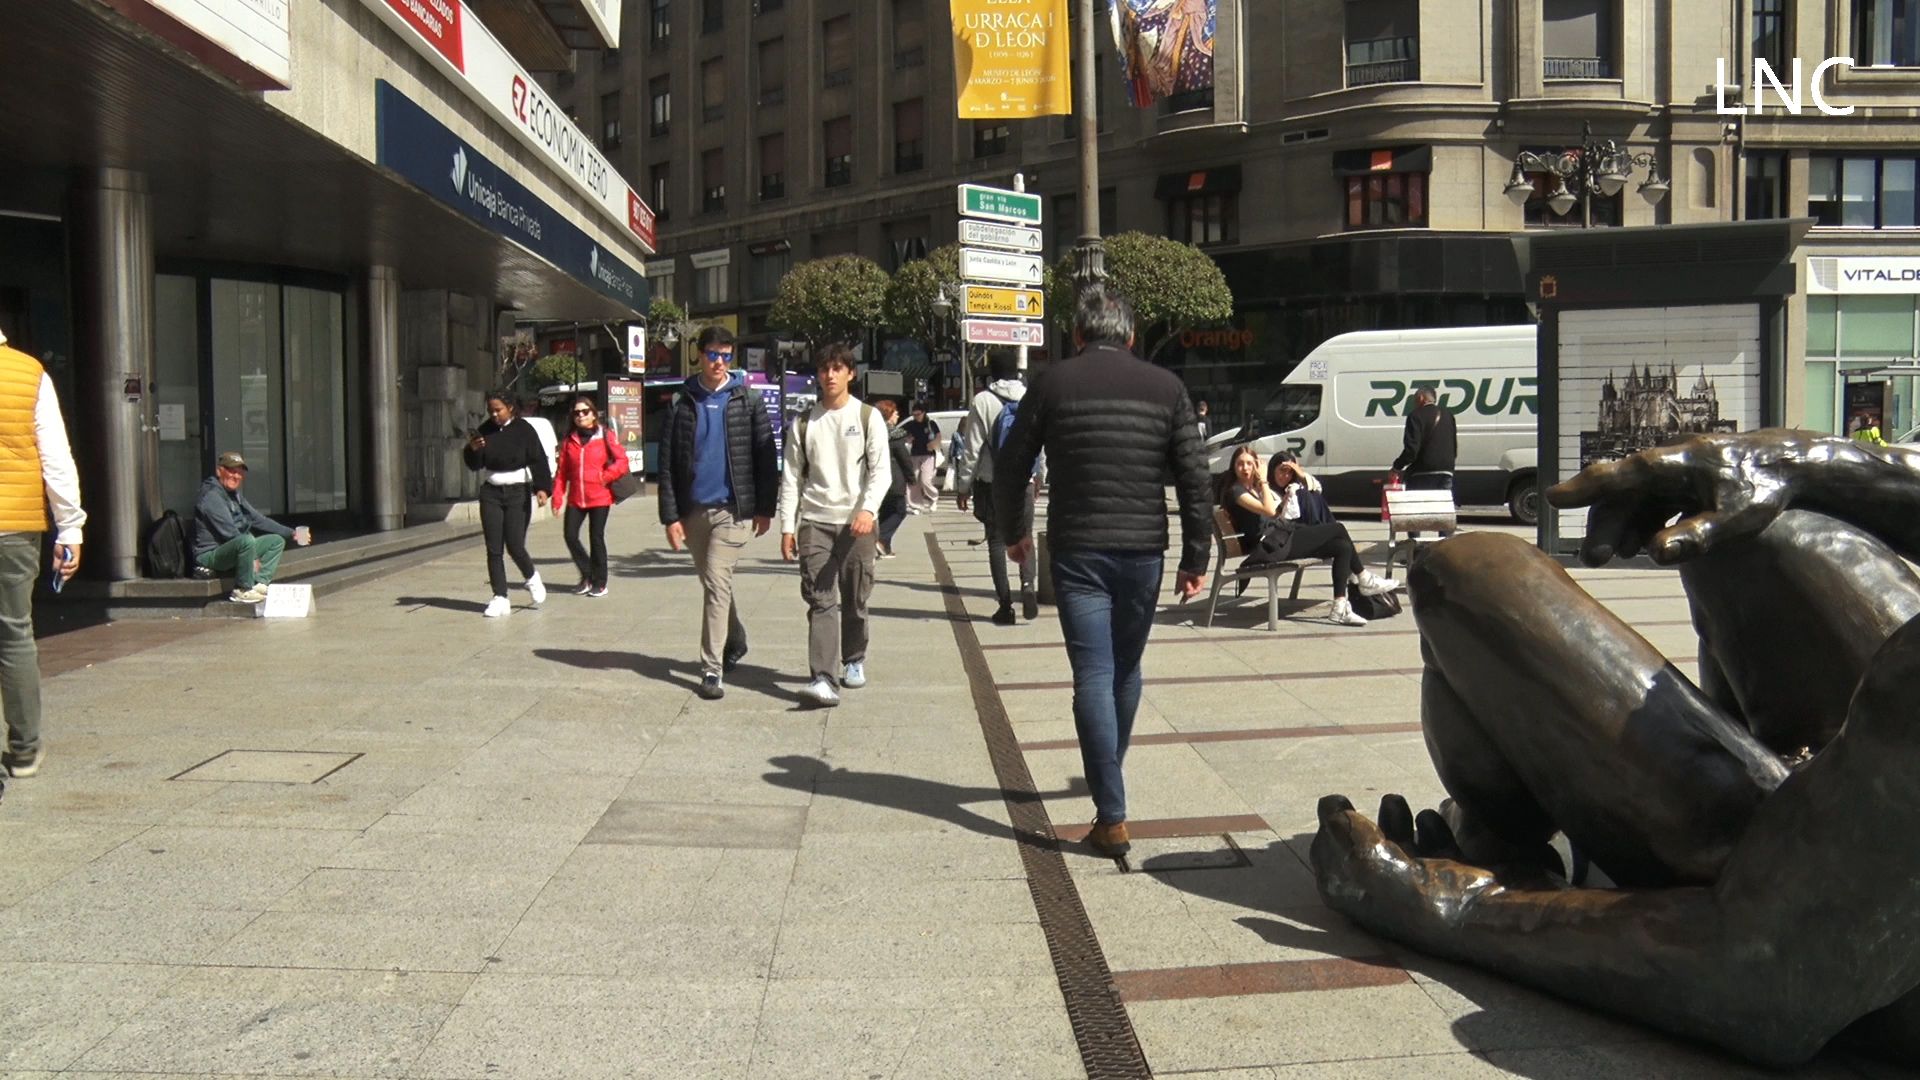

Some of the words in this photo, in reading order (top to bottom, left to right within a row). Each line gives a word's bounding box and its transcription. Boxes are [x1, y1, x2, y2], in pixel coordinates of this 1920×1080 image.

[965, 12, 1043, 31] URRACA
[996, 28, 1046, 48] LEÓN
[588, 152, 608, 200] ZERO
[468, 170, 496, 218] Unicaja
[497, 192, 519, 227] Banca
[980, 201, 995, 211] San
[998, 203, 1027, 216] Marcos
[971, 327, 983, 336] San
[987, 328, 1009, 337] Marcos
[1180, 329, 1254, 350] Orange
